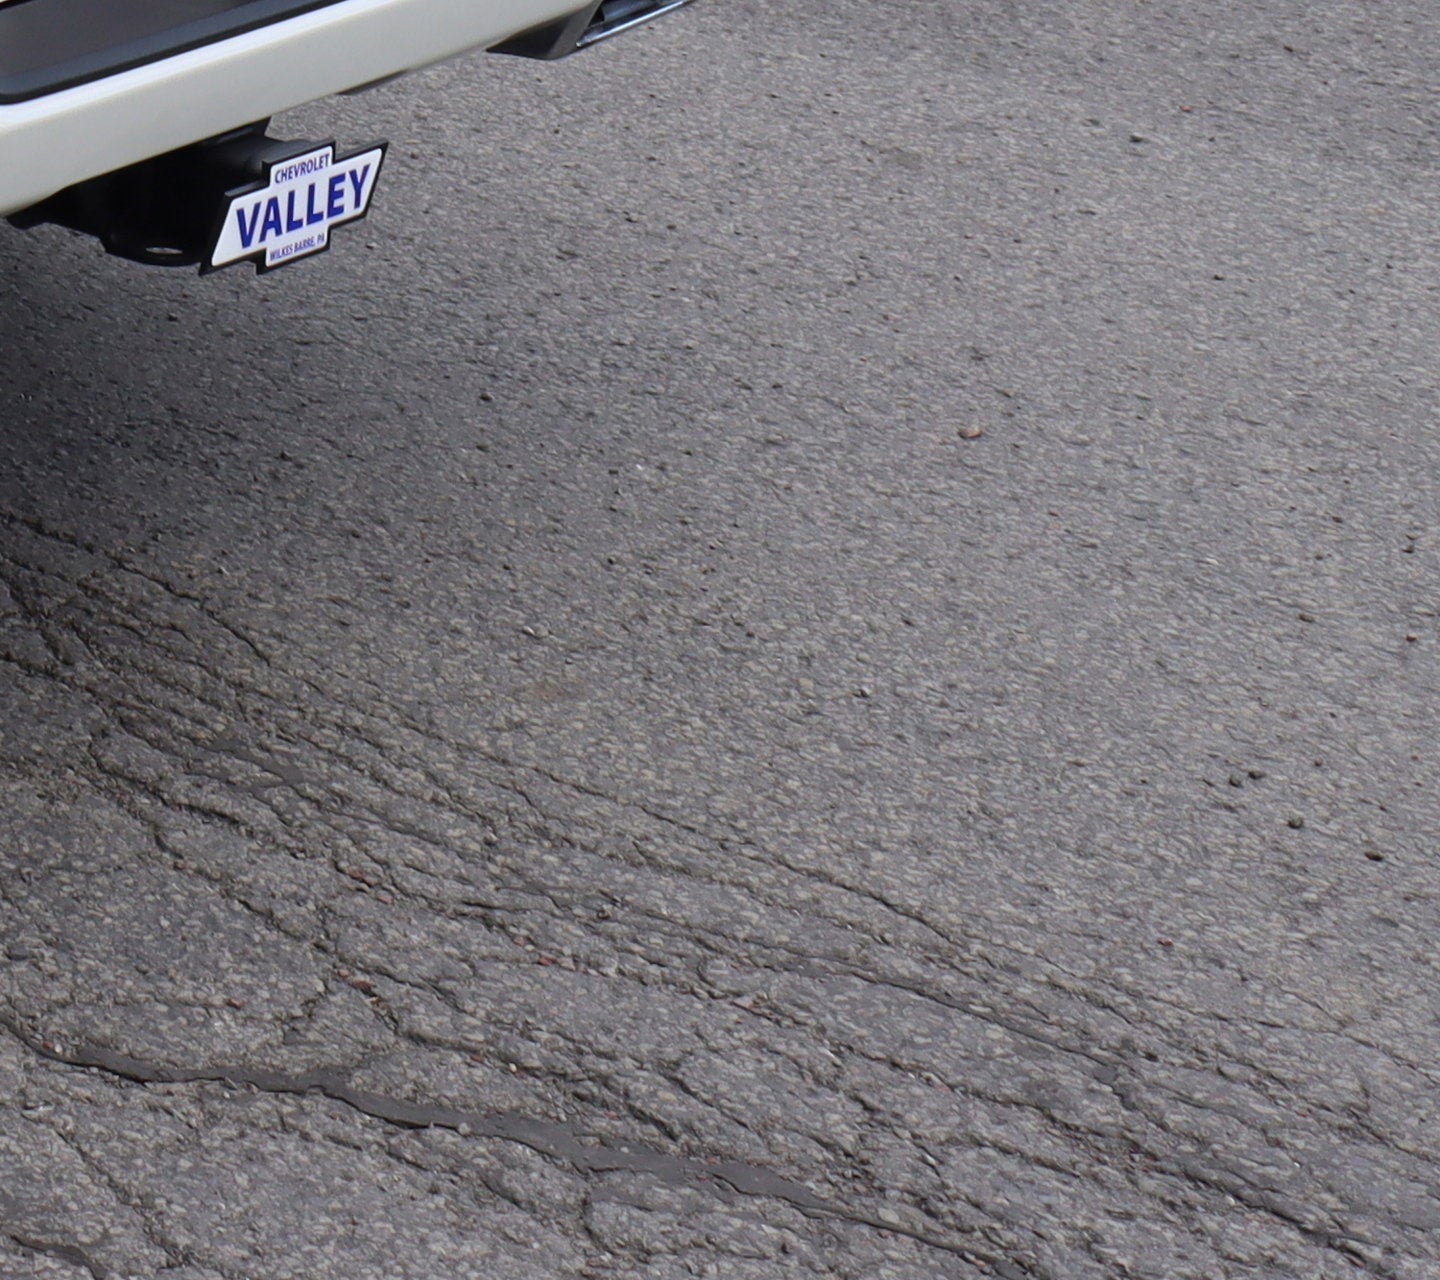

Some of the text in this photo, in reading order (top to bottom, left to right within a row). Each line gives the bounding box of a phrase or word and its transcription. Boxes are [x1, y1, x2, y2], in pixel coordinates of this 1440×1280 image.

[274, 153, 330, 185] CHEVROLET
[236, 163, 372, 250] VALLEY
[269, 243, 293, 262] WILKES
